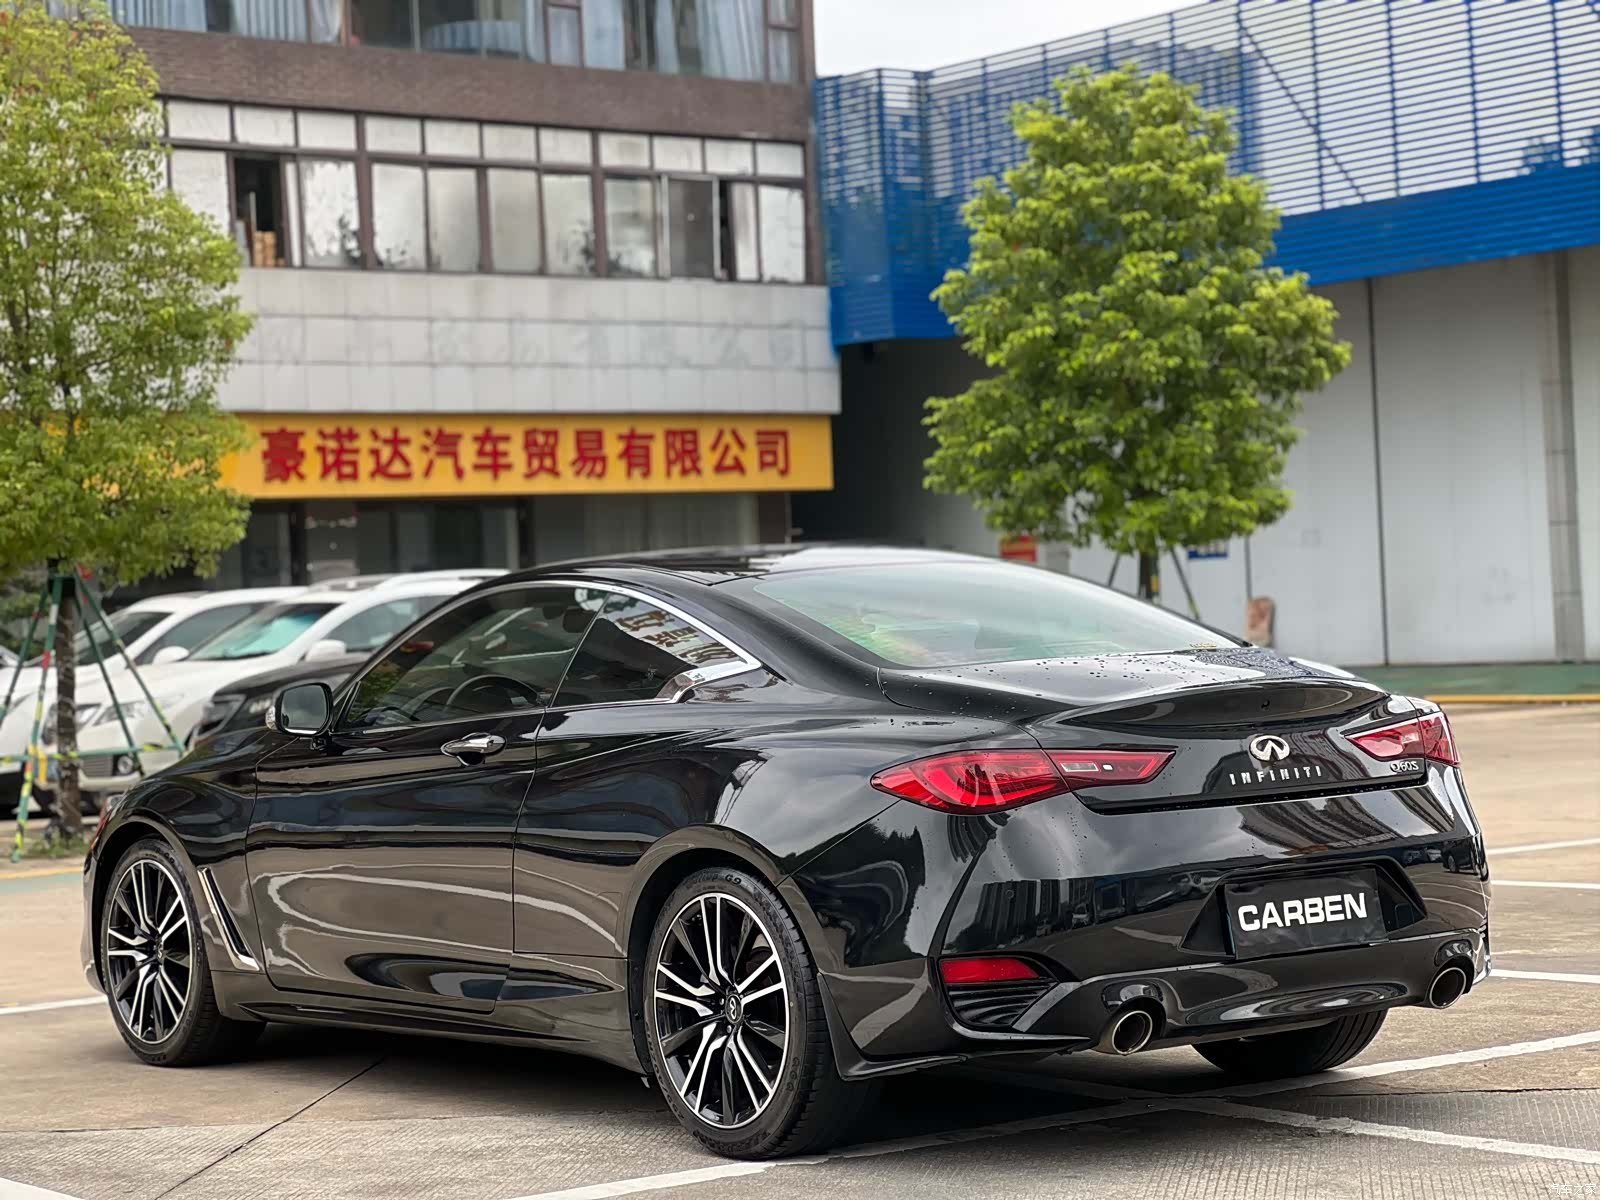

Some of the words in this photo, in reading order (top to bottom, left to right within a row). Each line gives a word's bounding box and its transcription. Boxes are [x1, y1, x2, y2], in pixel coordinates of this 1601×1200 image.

[260, 426, 792, 483] 豪诺达汽车贸易有限公司
[1229, 766, 1322, 785] INFINITI
[1237, 893, 1367, 931] CARBEN
